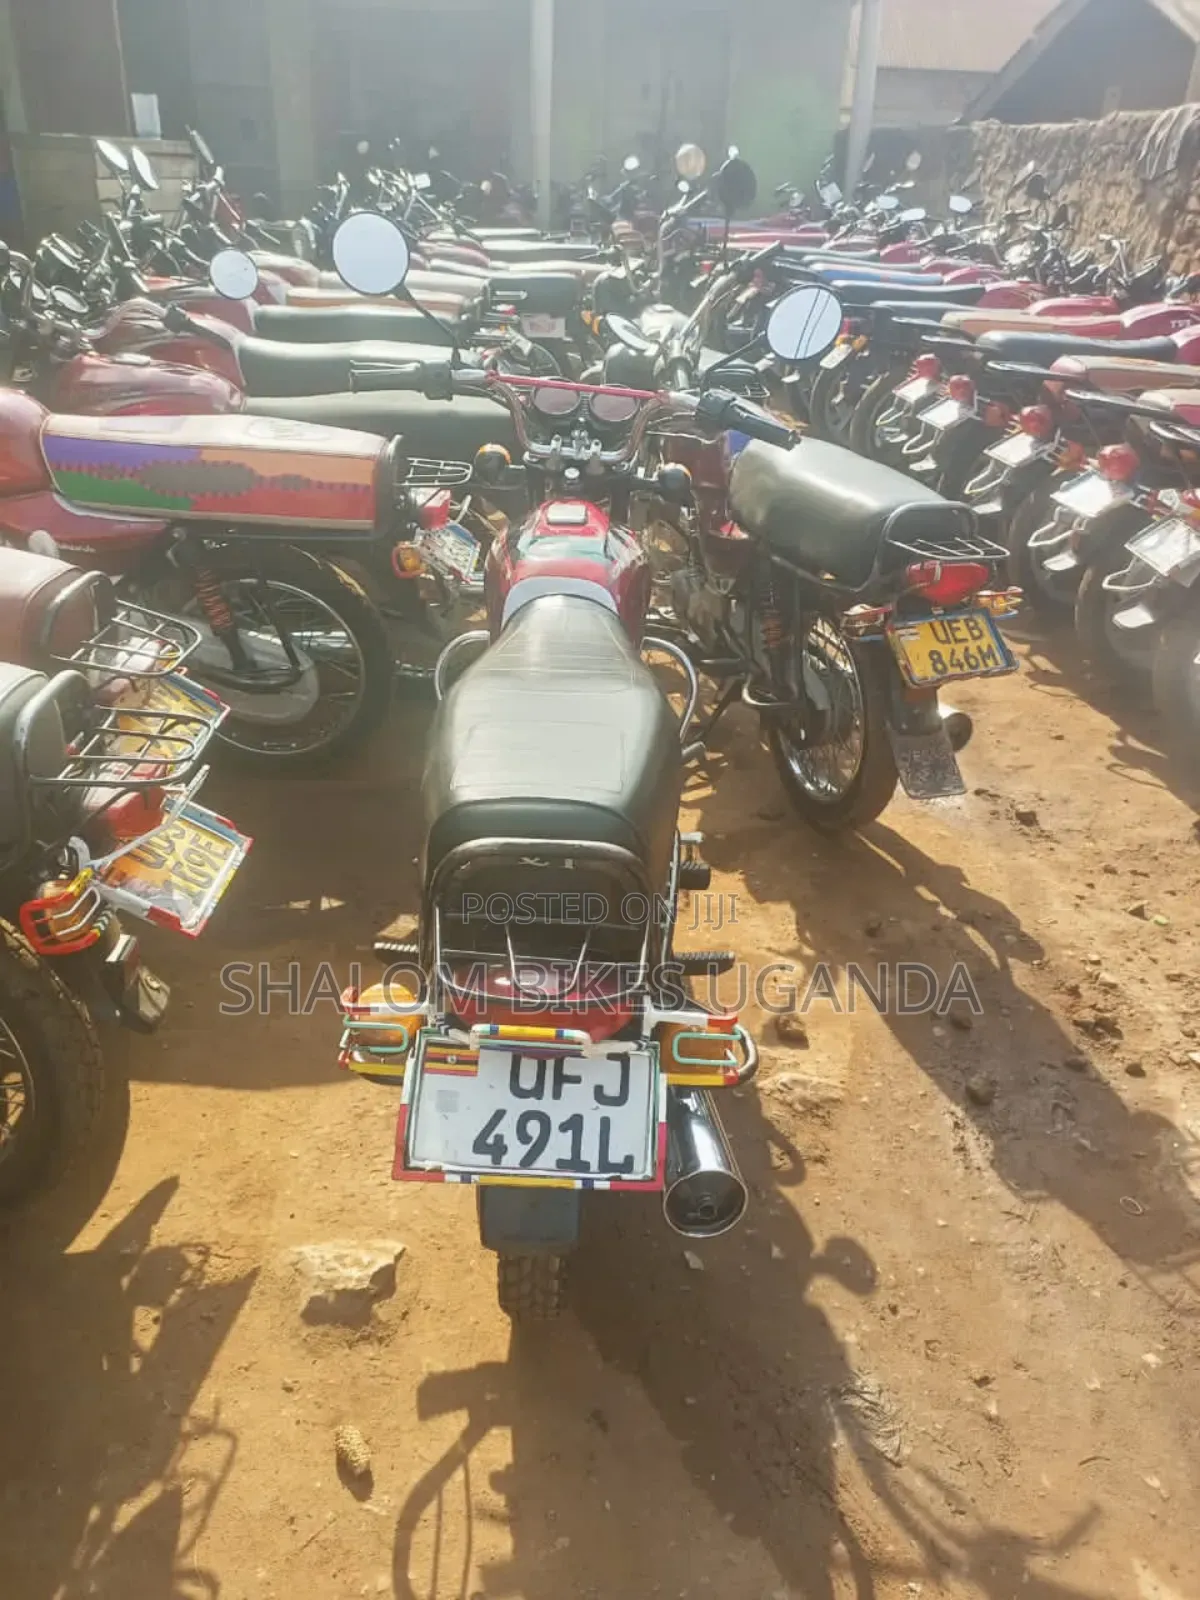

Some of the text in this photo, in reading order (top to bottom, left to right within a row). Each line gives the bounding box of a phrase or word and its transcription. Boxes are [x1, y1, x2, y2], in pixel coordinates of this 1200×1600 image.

[929, 618, 983, 645] UEB
[928, 643, 1001, 675] 846M
[508, 1051, 631, 1107] UFJ
[472, 1108, 635, 1174] 491L
